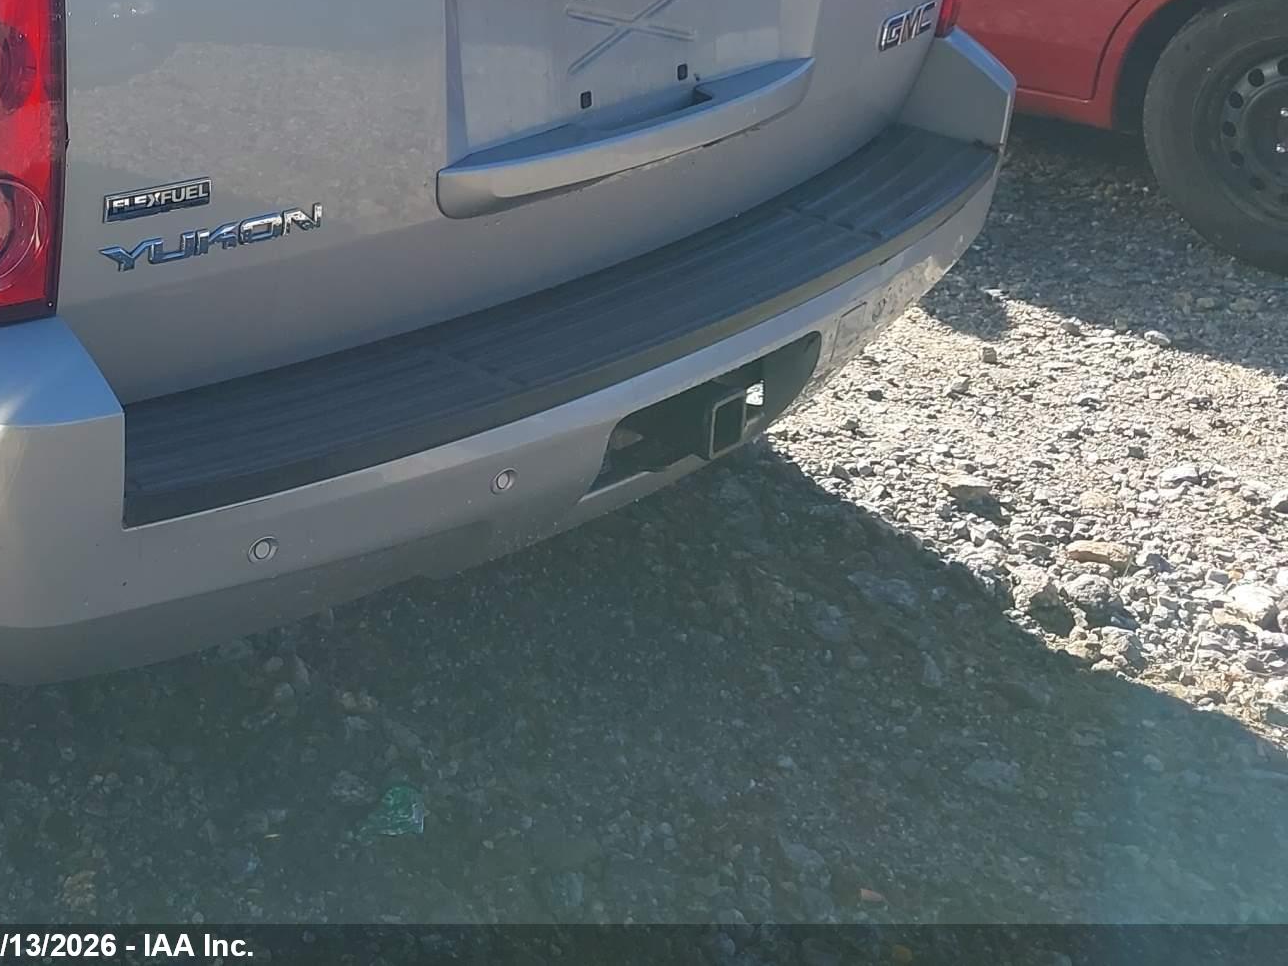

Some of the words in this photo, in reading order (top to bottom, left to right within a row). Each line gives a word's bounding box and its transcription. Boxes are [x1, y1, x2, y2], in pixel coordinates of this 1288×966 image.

[878, 0, 938, 52] GMC
[110, 182, 210, 214] FLEXFUEL
[99, 202, 323, 272] YUKON
